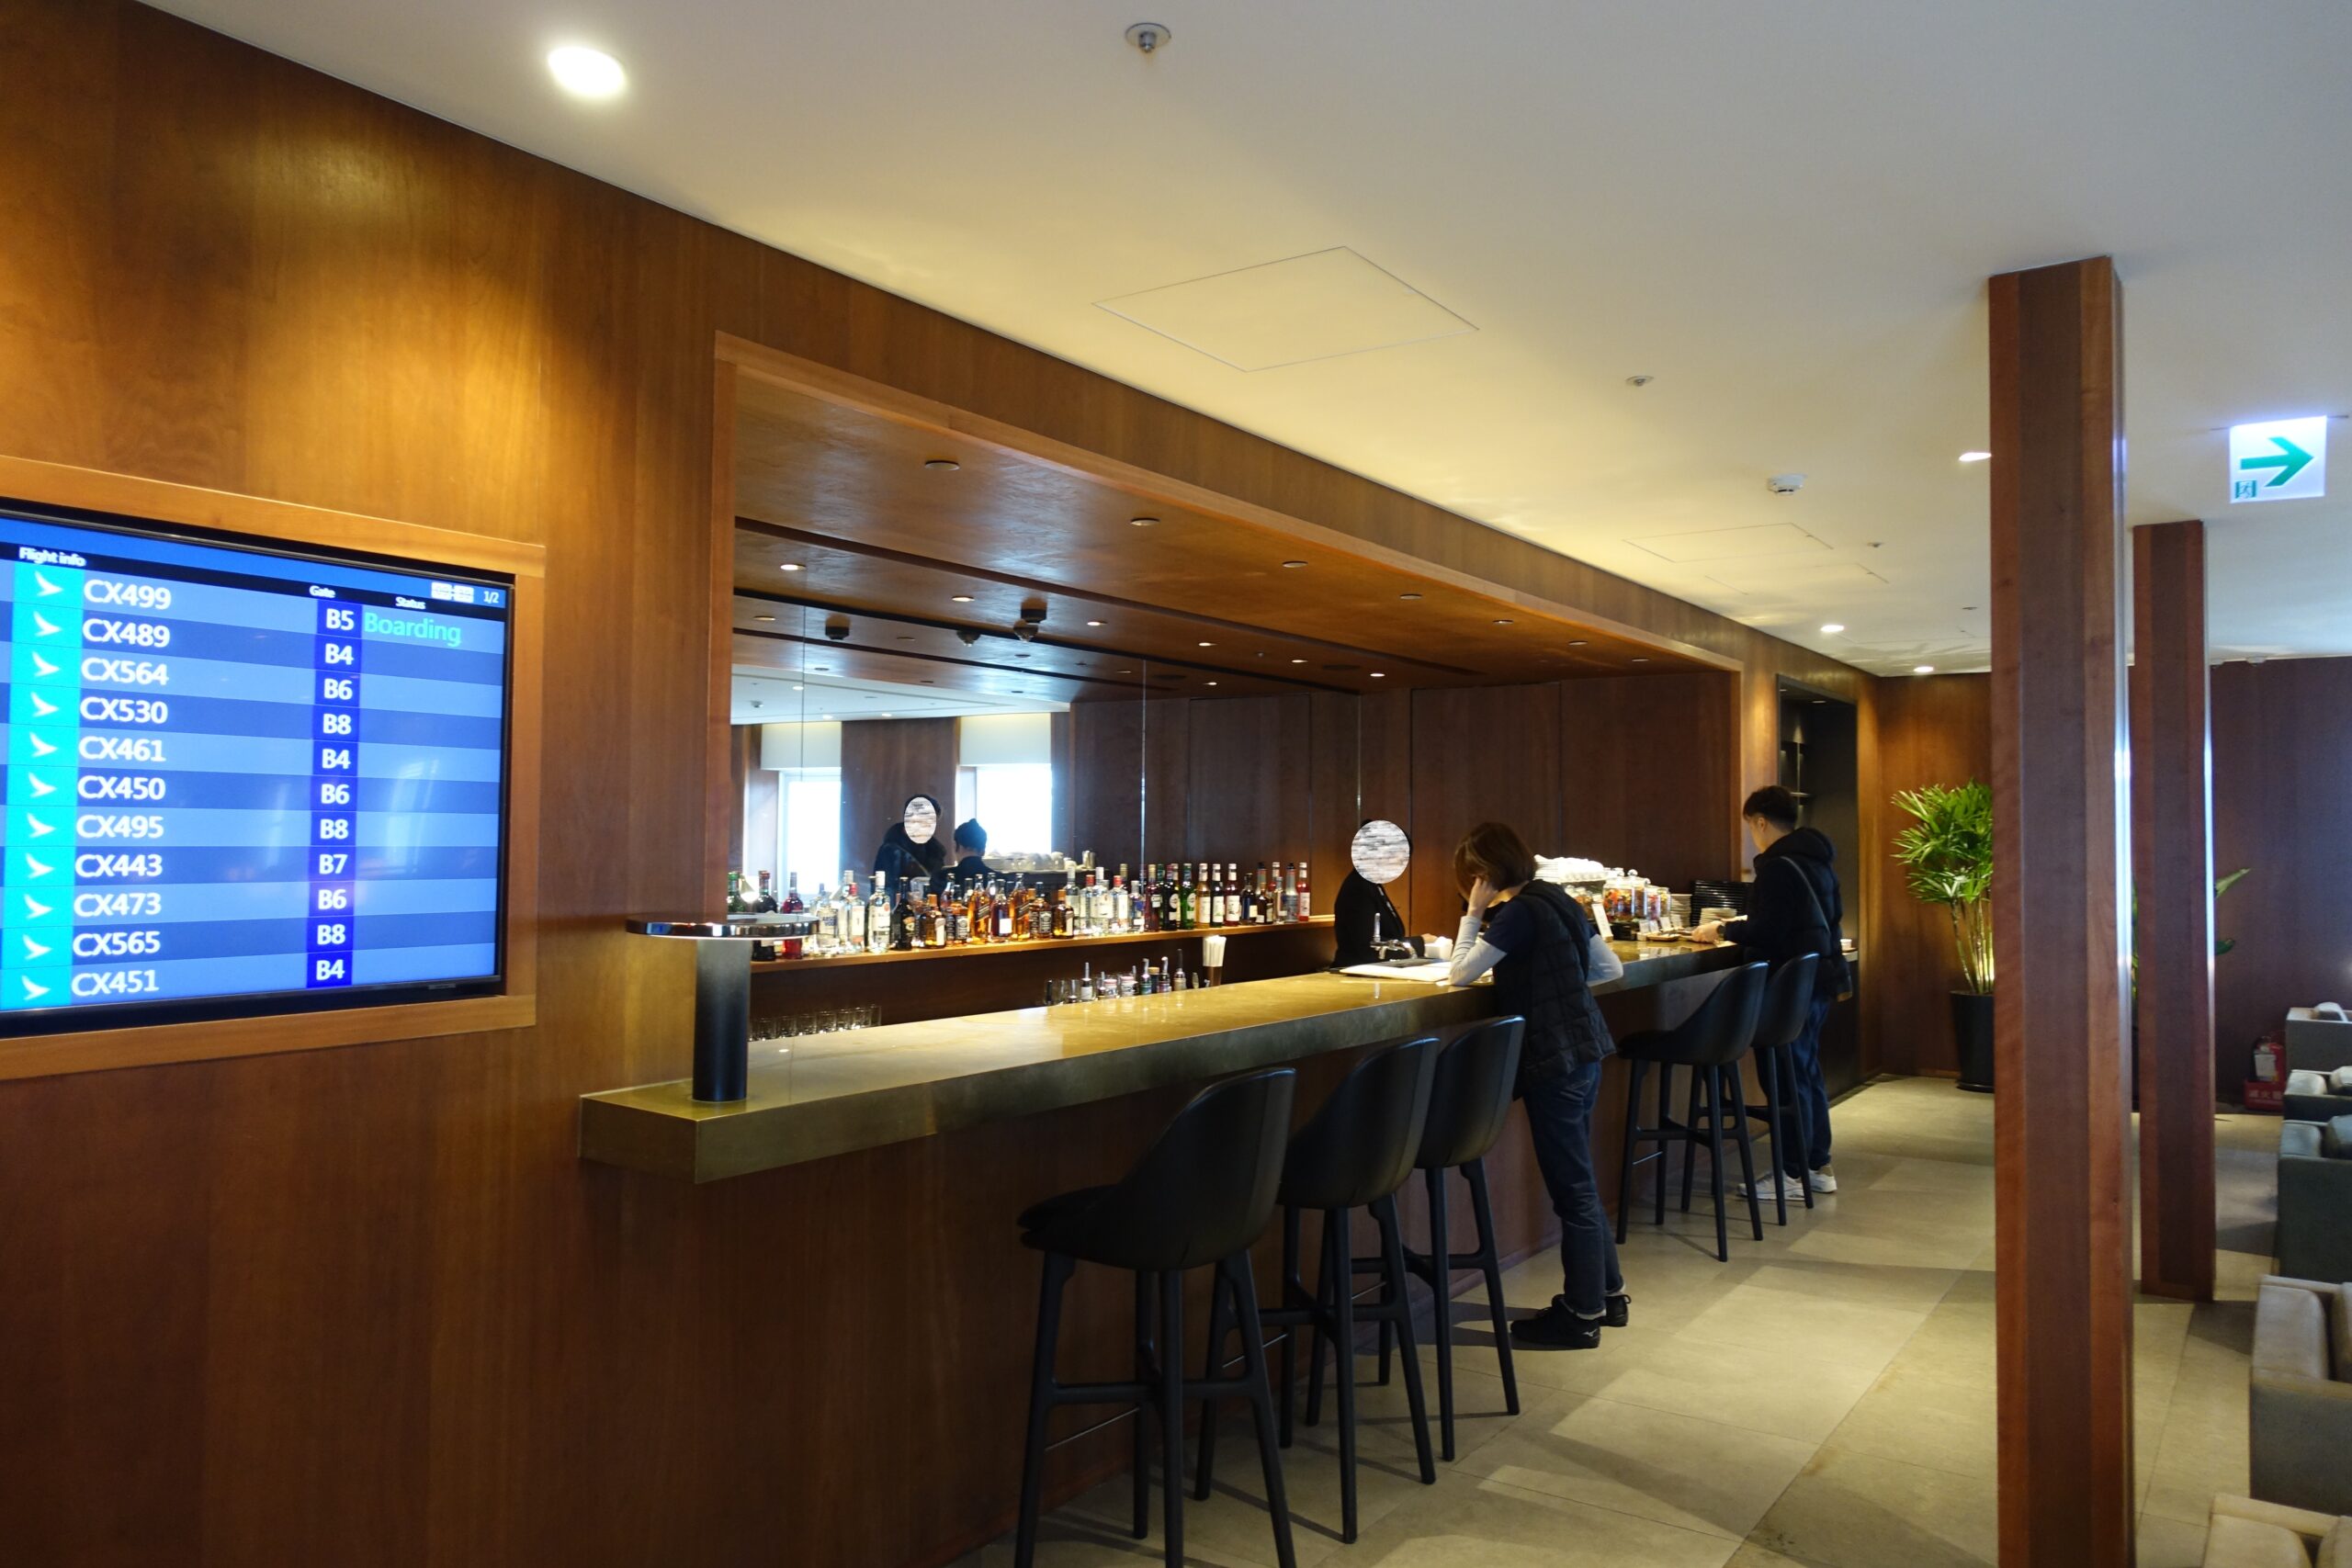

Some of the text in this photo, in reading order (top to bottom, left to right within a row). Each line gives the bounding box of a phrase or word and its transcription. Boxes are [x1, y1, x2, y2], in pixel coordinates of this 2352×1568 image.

[19, 547, 86, 567] Flight info
[310, 585, 335, 599] Gate
[396, 596, 425, 610] Status
[483, 591, 500, 604] 1/2
[84, 580, 461, 646] CX499 B5 Boarding
[83, 619, 354, 665] CX489 B4
[82, 658, 352, 700] CX564 B6
[81, 697, 351, 735] CX530 B8
[79, 738, 350, 770] CX461 B4
[78, 776, 349, 805] CX450 B6
[76, 816, 348, 840] CX495 B8
[75, 853, 347, 876] CX443 B7
[74, 889, 345, 916] CX473 B6
[73, 924, 345, 957] CX565 B8
[72, 959, 345, 997] CX451 B4
